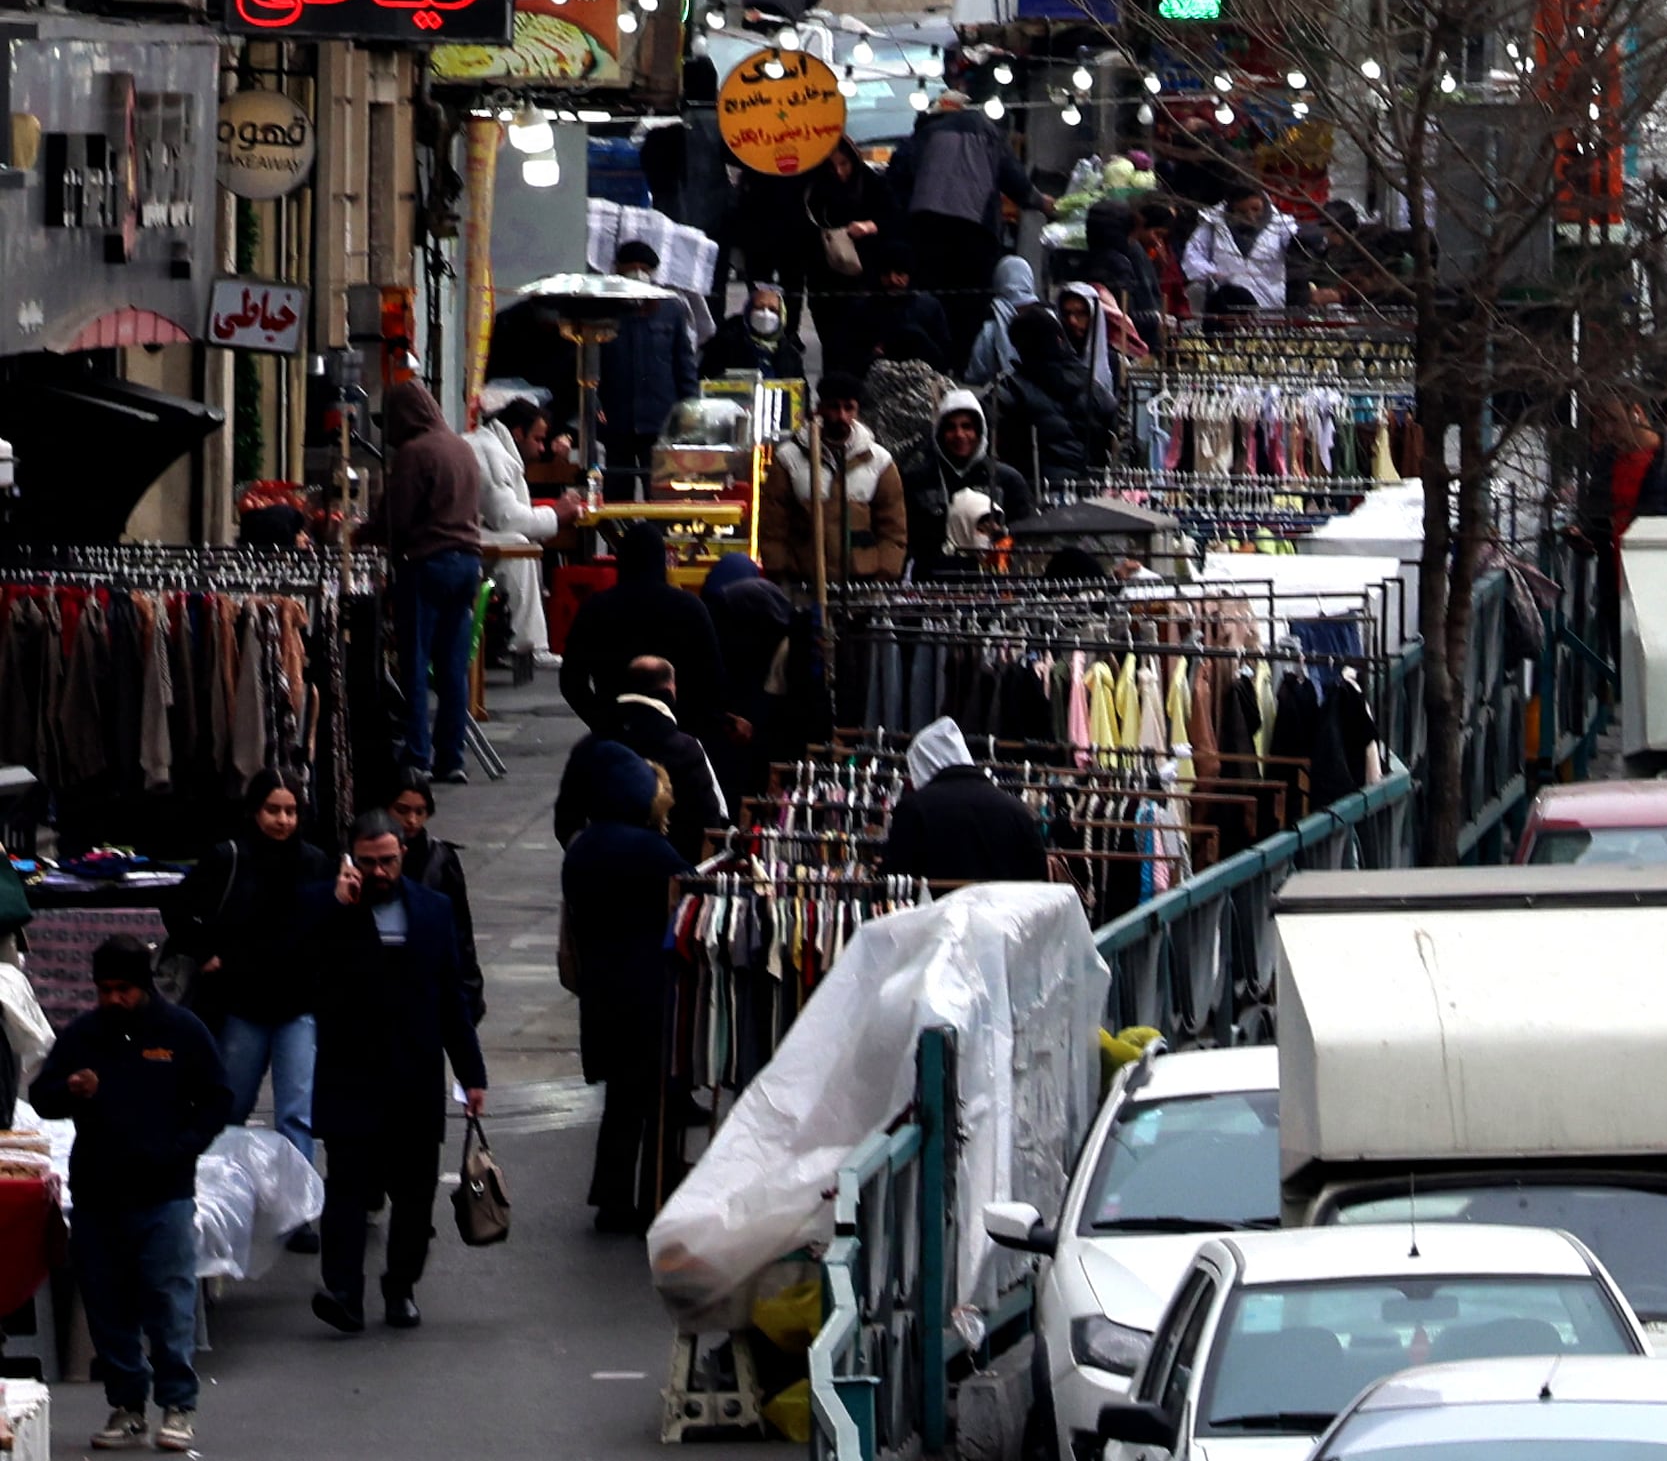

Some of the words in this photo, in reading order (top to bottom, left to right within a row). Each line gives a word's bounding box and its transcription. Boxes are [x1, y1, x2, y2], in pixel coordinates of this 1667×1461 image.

[741, 52, 808, 85] اسک
[216, 115, 307, 151] قهوه
[213, 287, 299, 340] خیاطی
